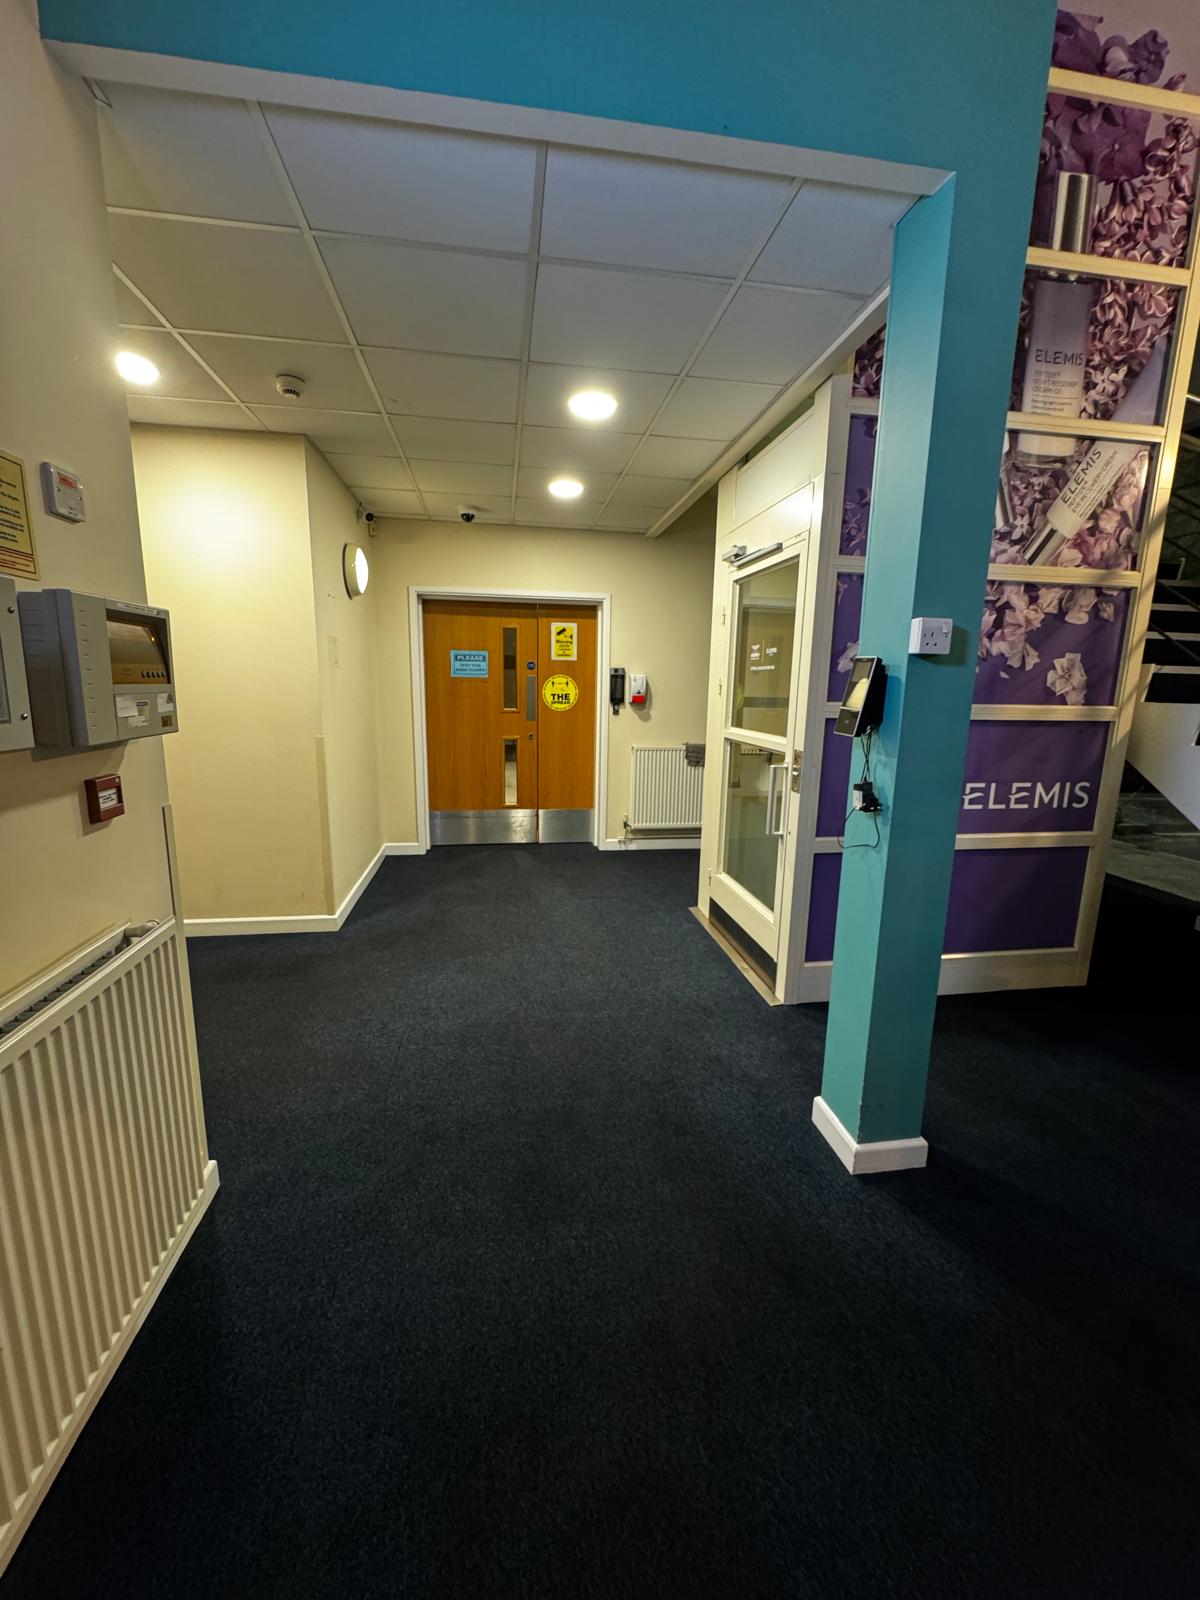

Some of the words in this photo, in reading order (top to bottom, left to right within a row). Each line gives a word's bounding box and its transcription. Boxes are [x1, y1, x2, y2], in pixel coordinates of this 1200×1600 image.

[1034, 348, 1084, 367] ELEMIS
[1060, 446, 1103, 505] ELEMIS
[551, 693, 571, 701] THE
[962, 781, 1091, 810] ELEMIS
